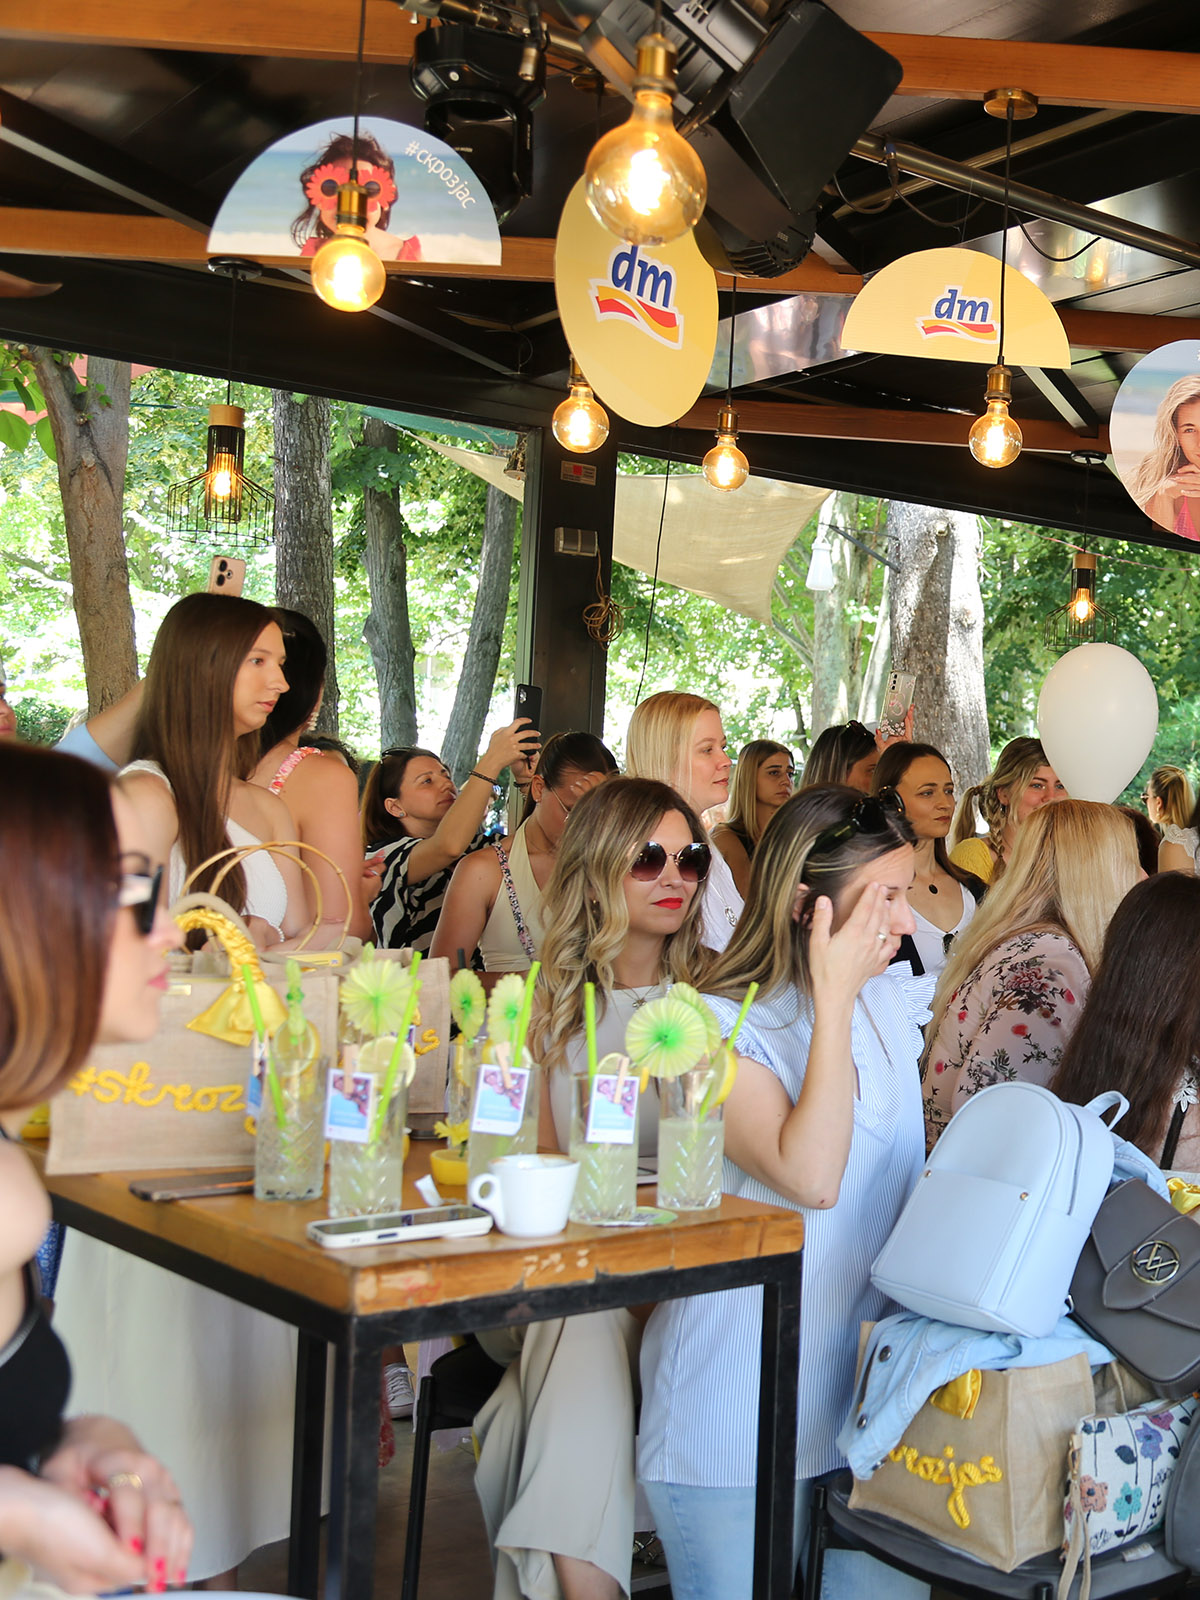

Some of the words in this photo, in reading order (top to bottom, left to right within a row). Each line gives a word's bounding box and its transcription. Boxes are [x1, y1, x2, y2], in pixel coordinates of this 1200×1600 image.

[405, 141, 476, 209] #скрозјас
[611, 244, 673, 309] dm
[934, 288, 990, 323] dm
[67, 1061, 248, 1116] #skroz
